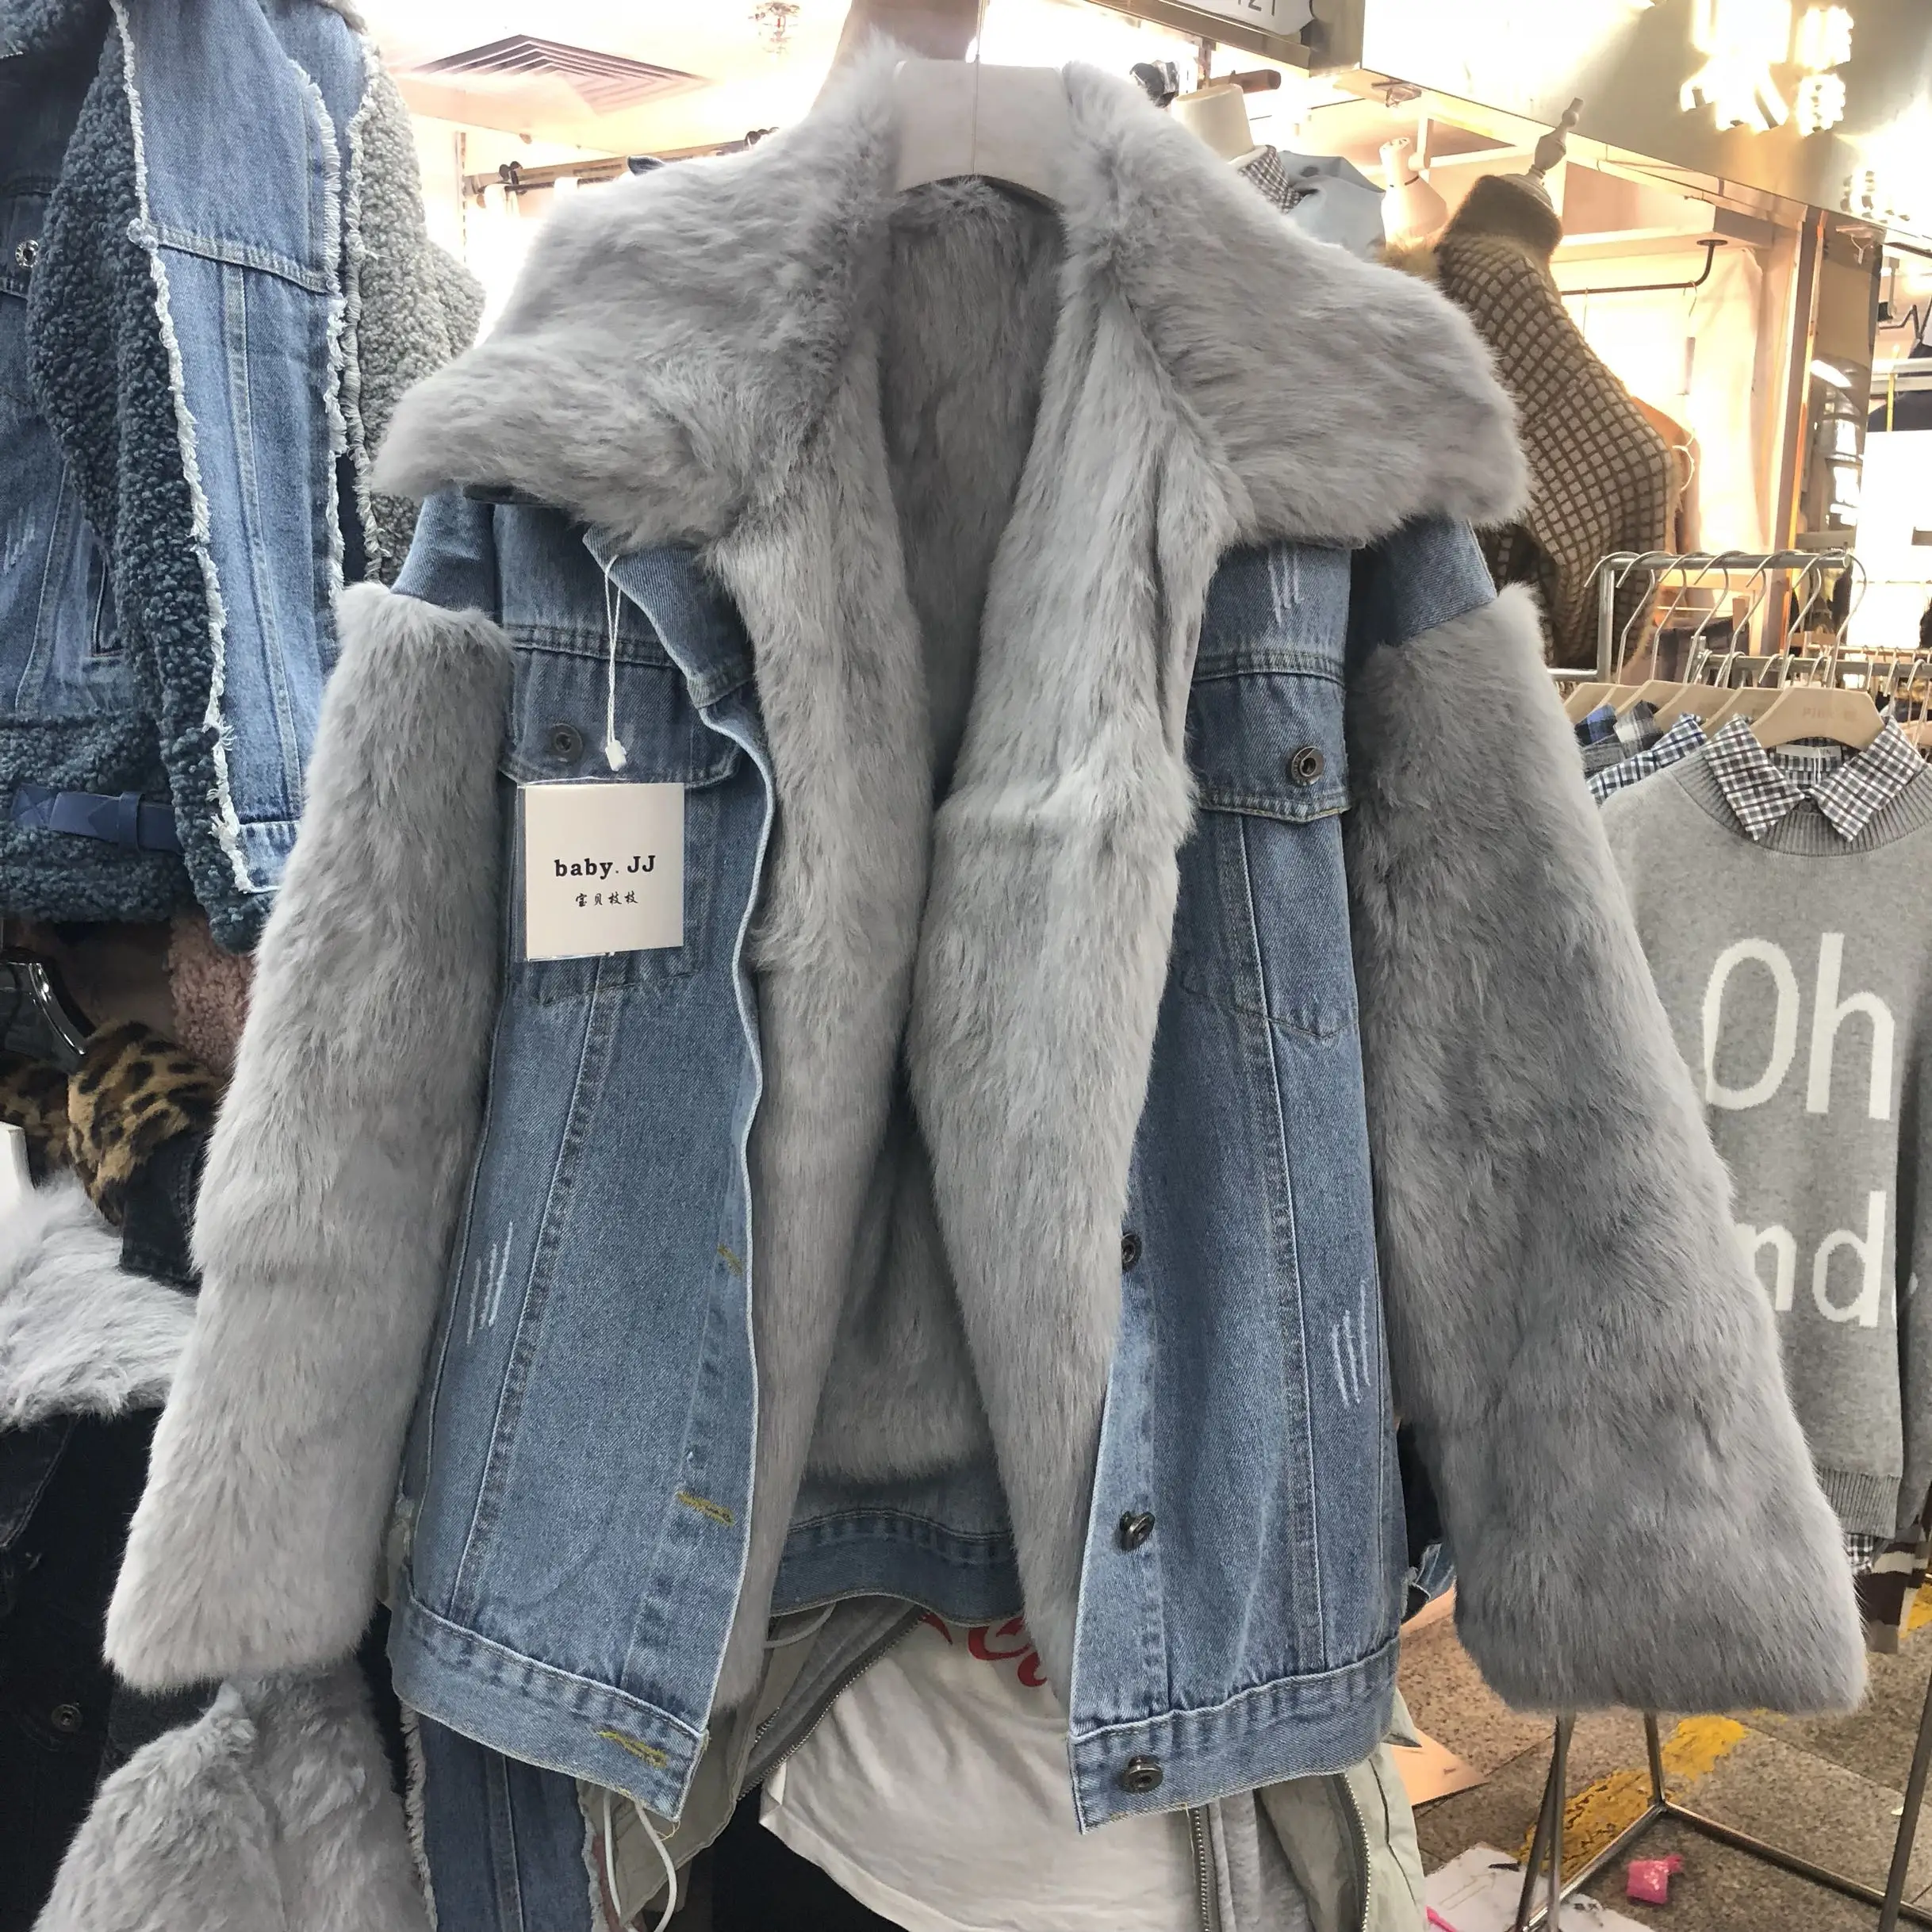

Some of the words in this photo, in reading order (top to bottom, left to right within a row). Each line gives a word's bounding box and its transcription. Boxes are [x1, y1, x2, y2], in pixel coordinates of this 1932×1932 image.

[1238, 0, 1275, 16] 21
[554, 858, 619, 880] baby.
[627, 855, 656, 872] JJ
[1702, 933, 1896, 1120] Oh
